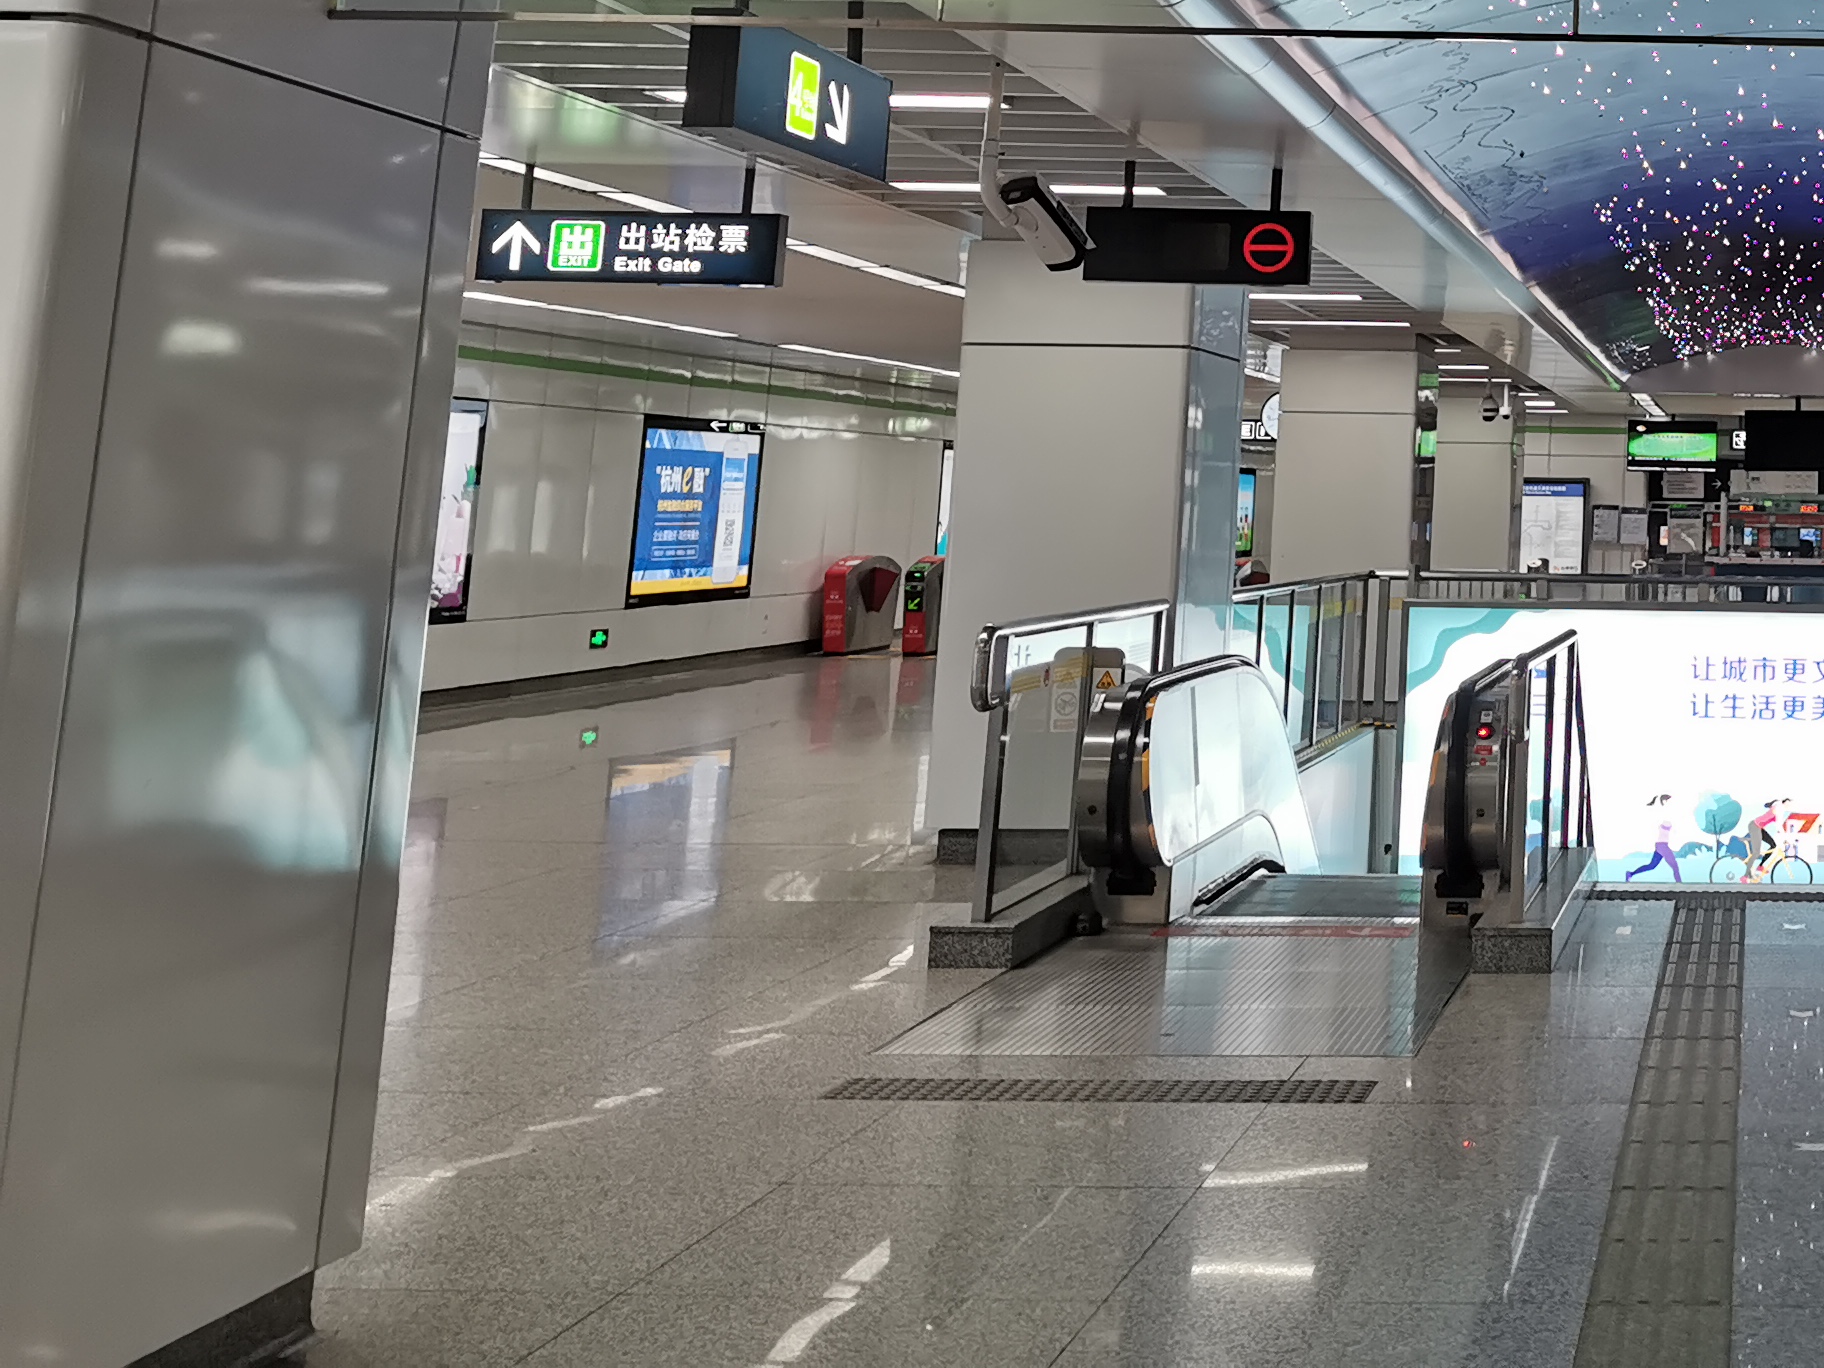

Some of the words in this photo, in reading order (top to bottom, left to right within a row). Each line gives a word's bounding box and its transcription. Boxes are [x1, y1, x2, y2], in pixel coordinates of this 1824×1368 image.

[617, 222, 750, 254] 出站检票
[558, 255, 592, 267] EXIT
[614, 256, 652, 273] Exit
[658, 257, 702, 274] Gate
